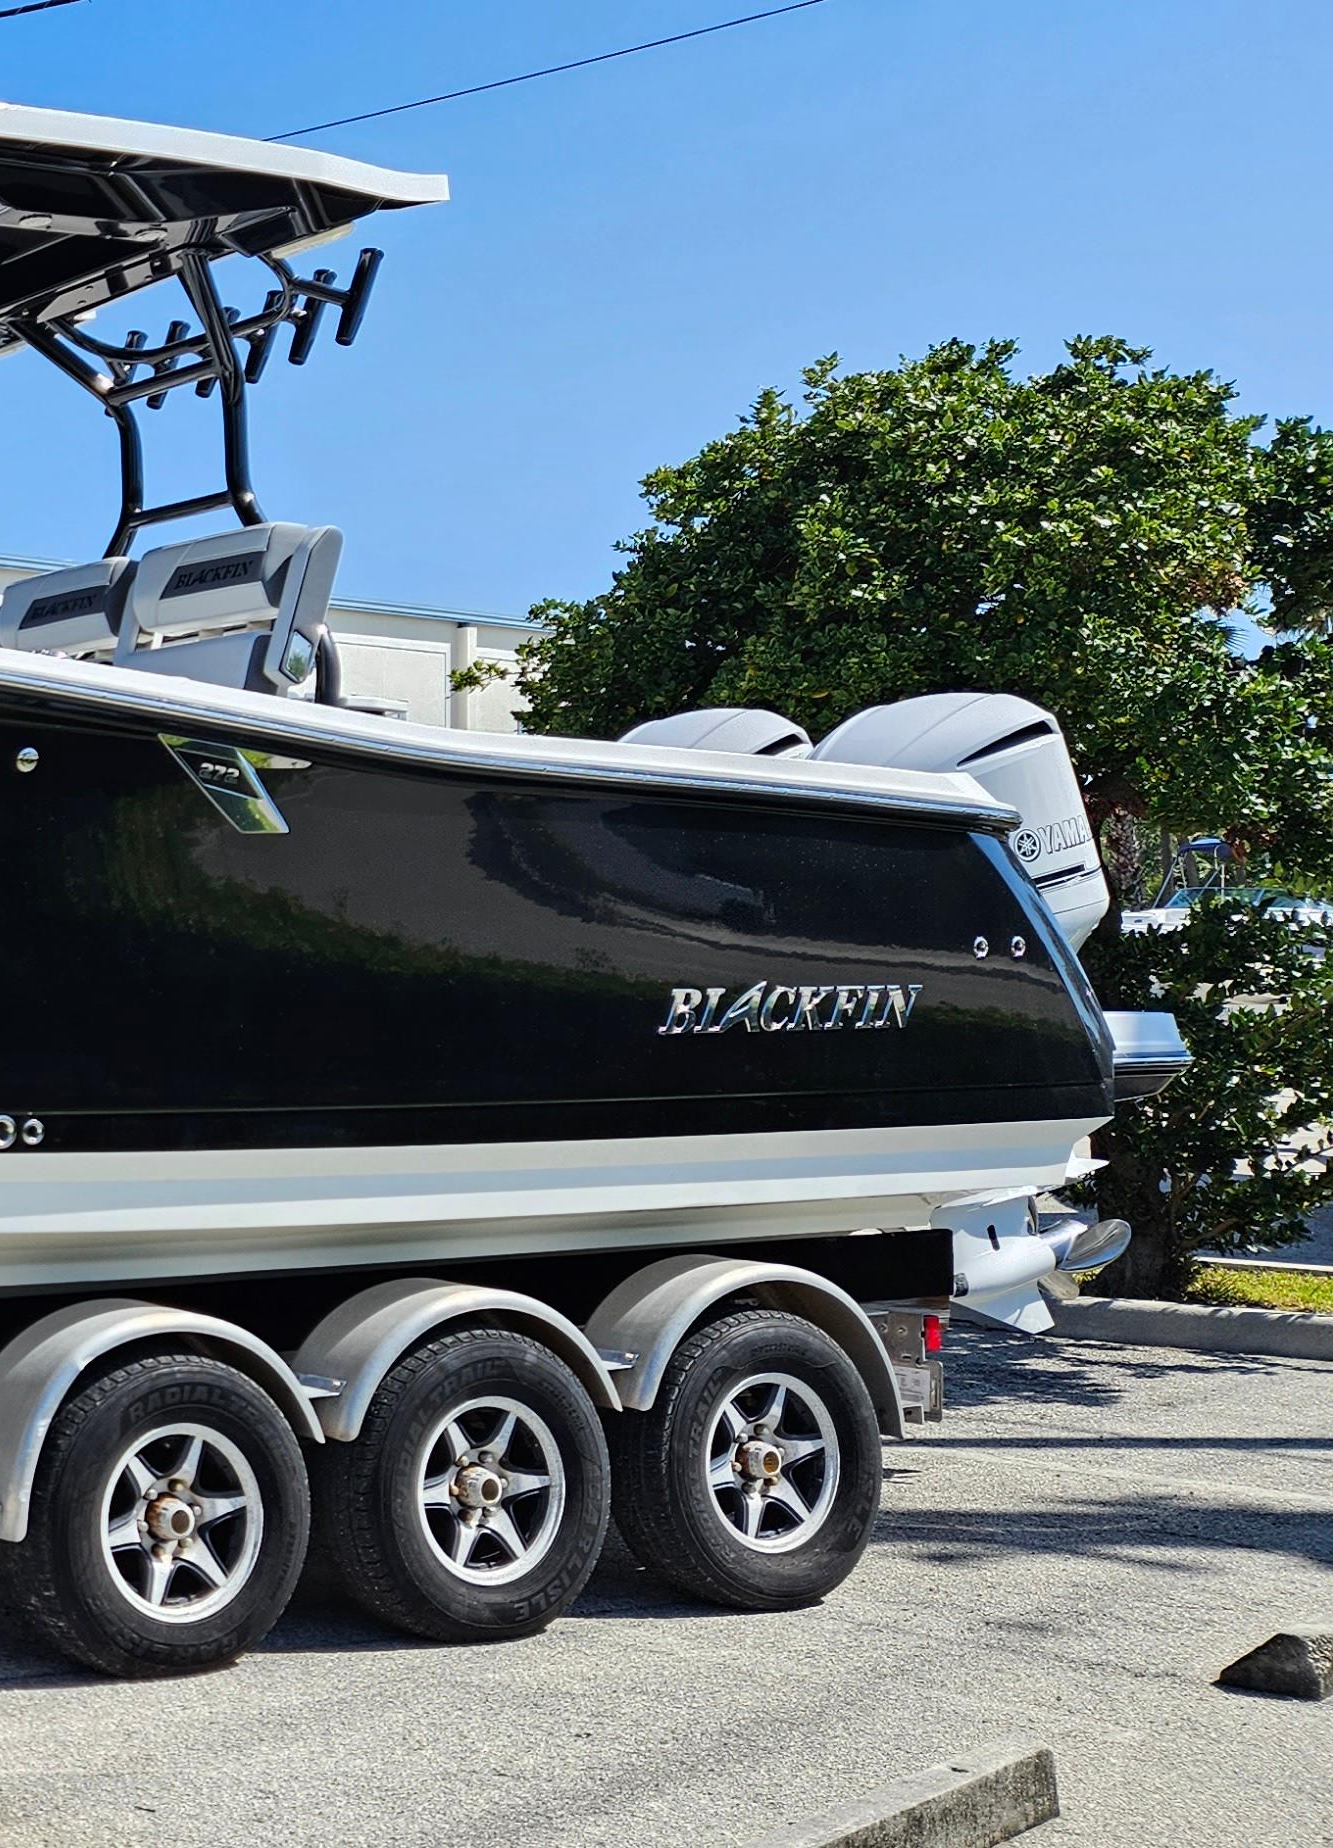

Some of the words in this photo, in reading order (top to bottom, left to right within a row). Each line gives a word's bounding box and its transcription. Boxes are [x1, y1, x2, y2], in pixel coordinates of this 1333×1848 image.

[174, 560, 253, 590] BLACKFIN
[32, 594, 96, 619] BLACKFIN
[199, 762, 240, 784] 272
[657, 981, 923, 1035] BLACKFIN
[128, 1384, 229, 1423] RADIAL
